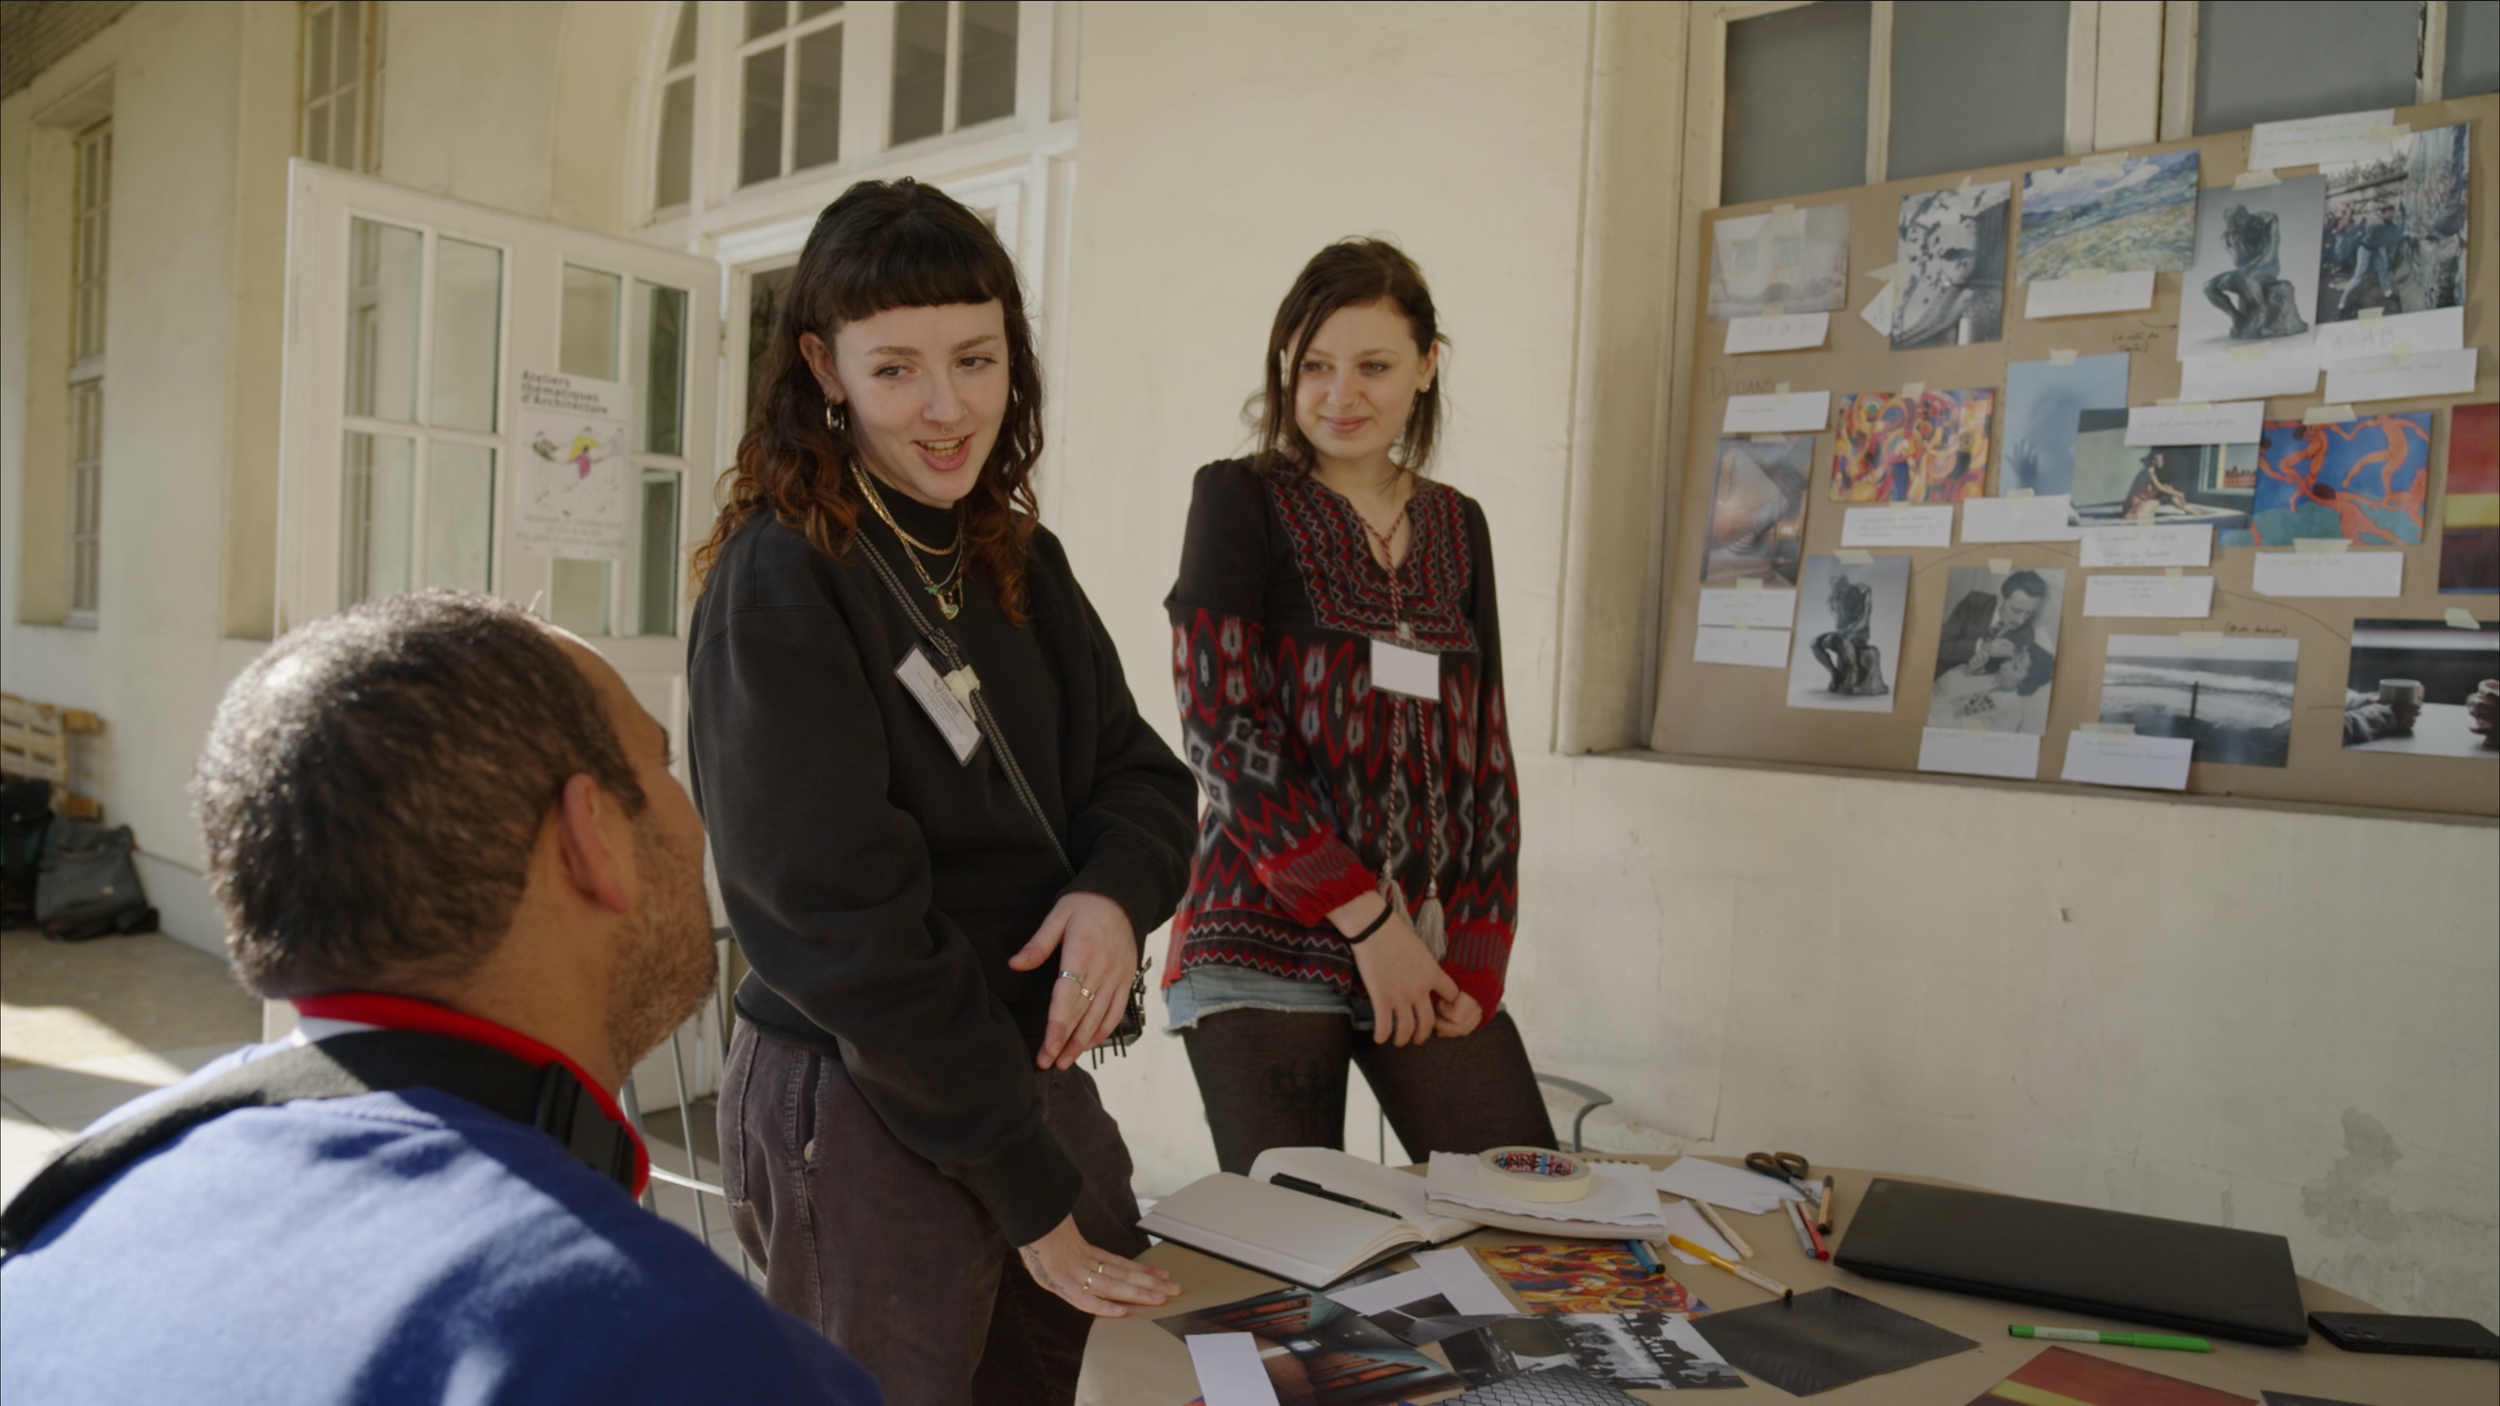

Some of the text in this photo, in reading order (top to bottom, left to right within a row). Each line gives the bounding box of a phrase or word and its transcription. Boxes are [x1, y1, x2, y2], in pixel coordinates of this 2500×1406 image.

[2331, 326, 2395, 351] ACAB
[521, 369, 571, 387] Ateliers
[521, 382, 599, 402] thématiques
[520, 394, 609, 415] d'Architecture
